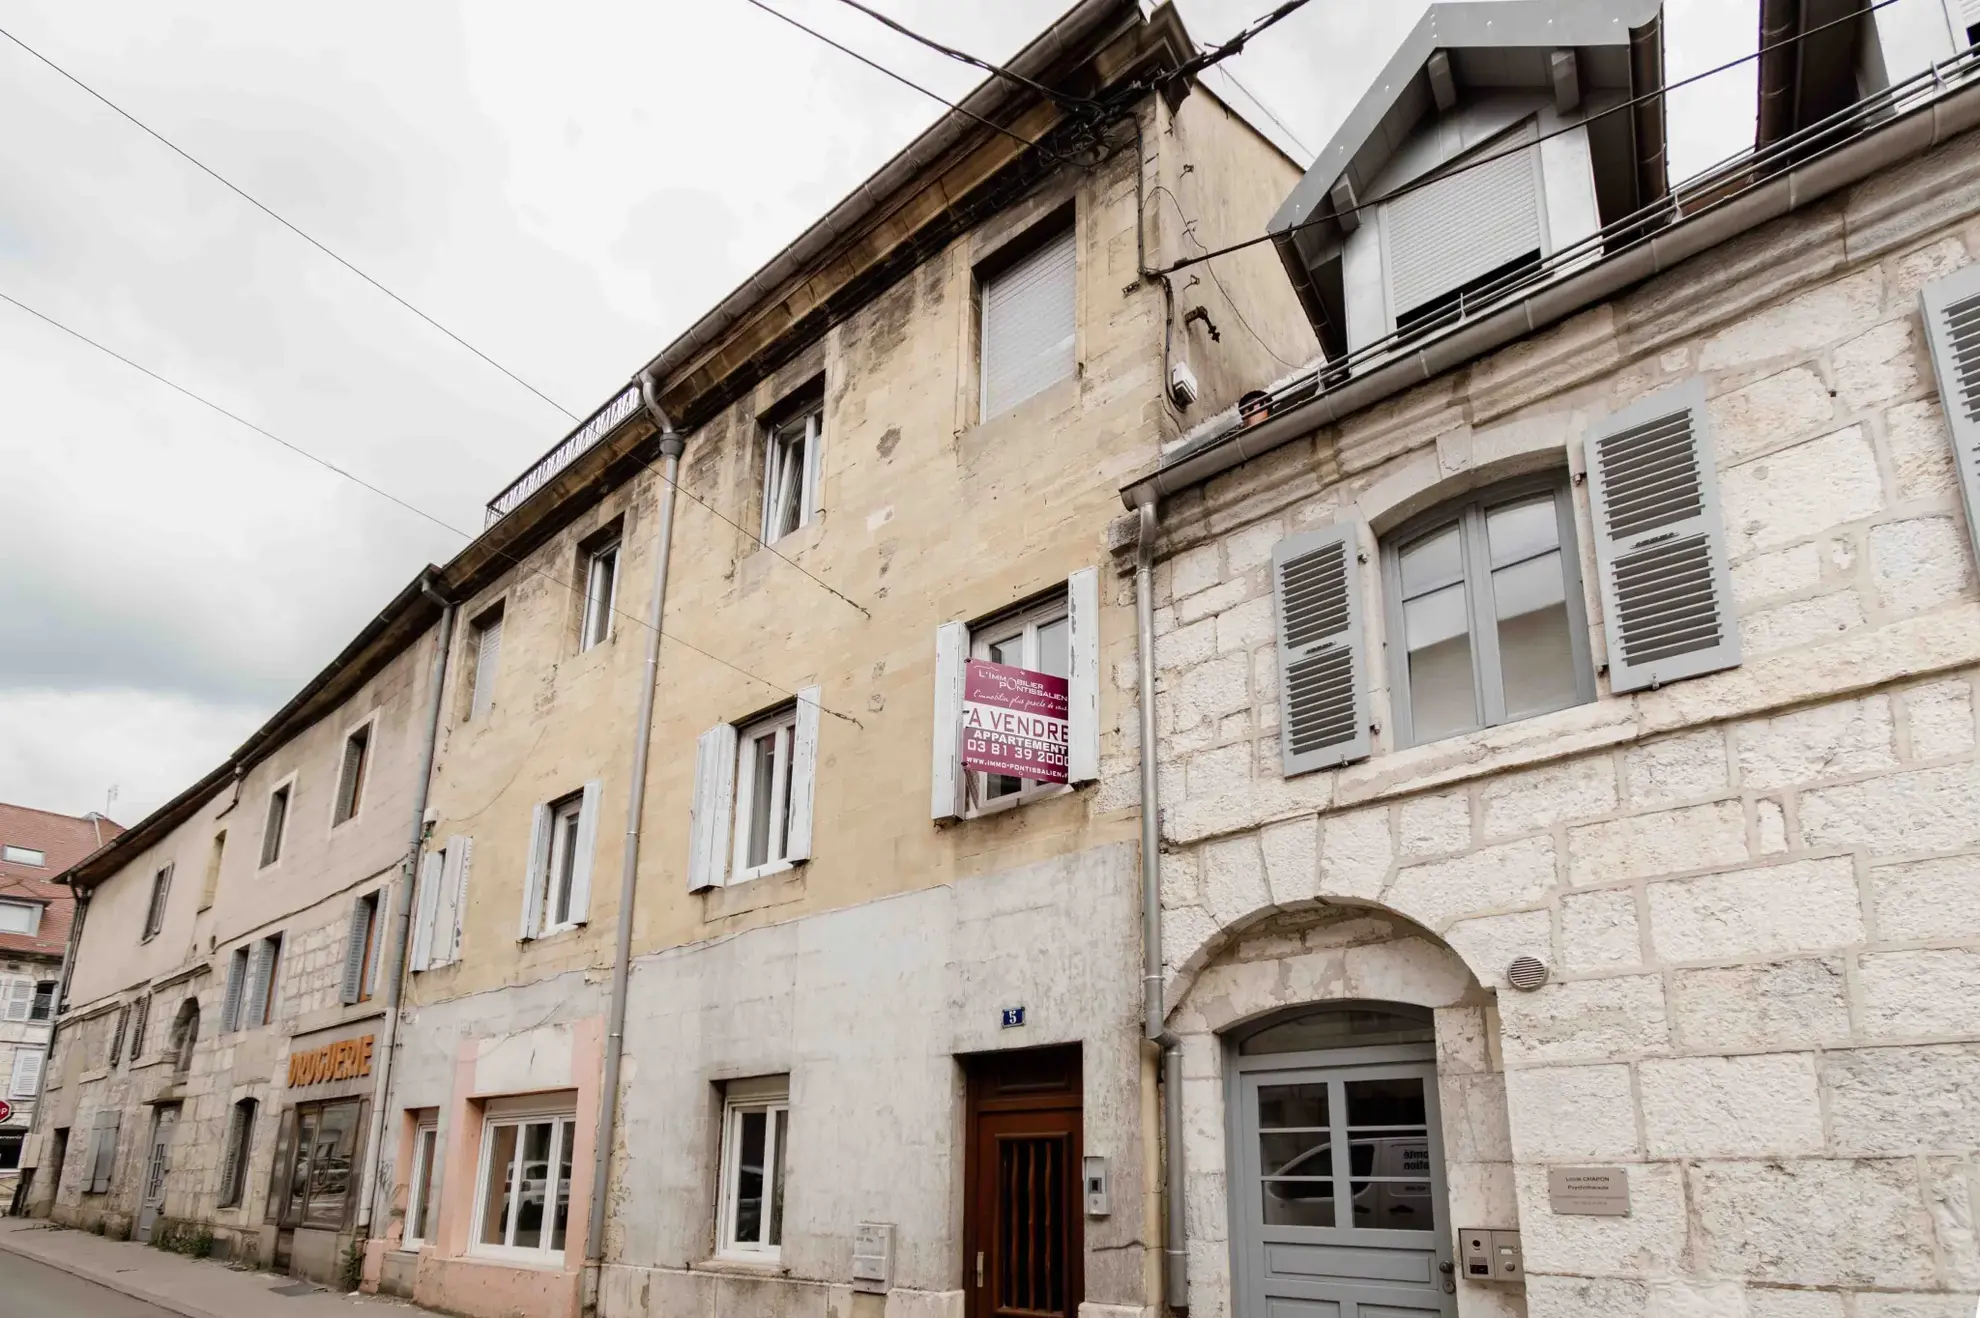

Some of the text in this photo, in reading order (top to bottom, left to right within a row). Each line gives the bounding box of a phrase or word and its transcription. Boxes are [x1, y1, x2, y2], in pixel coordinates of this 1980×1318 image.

[999, 680, 1068, 702] PONTISSALIEN
[968, 707, 1068, 743] A VENDRE
[967, 739, 986, 752] 03
[991, 743, 1007, 756] 81
[1014, 747, 1032, 760] 39
[974, 729, 1067, 754] APPARTEMENT
[1009, 1010, 1017, 1024] 5
